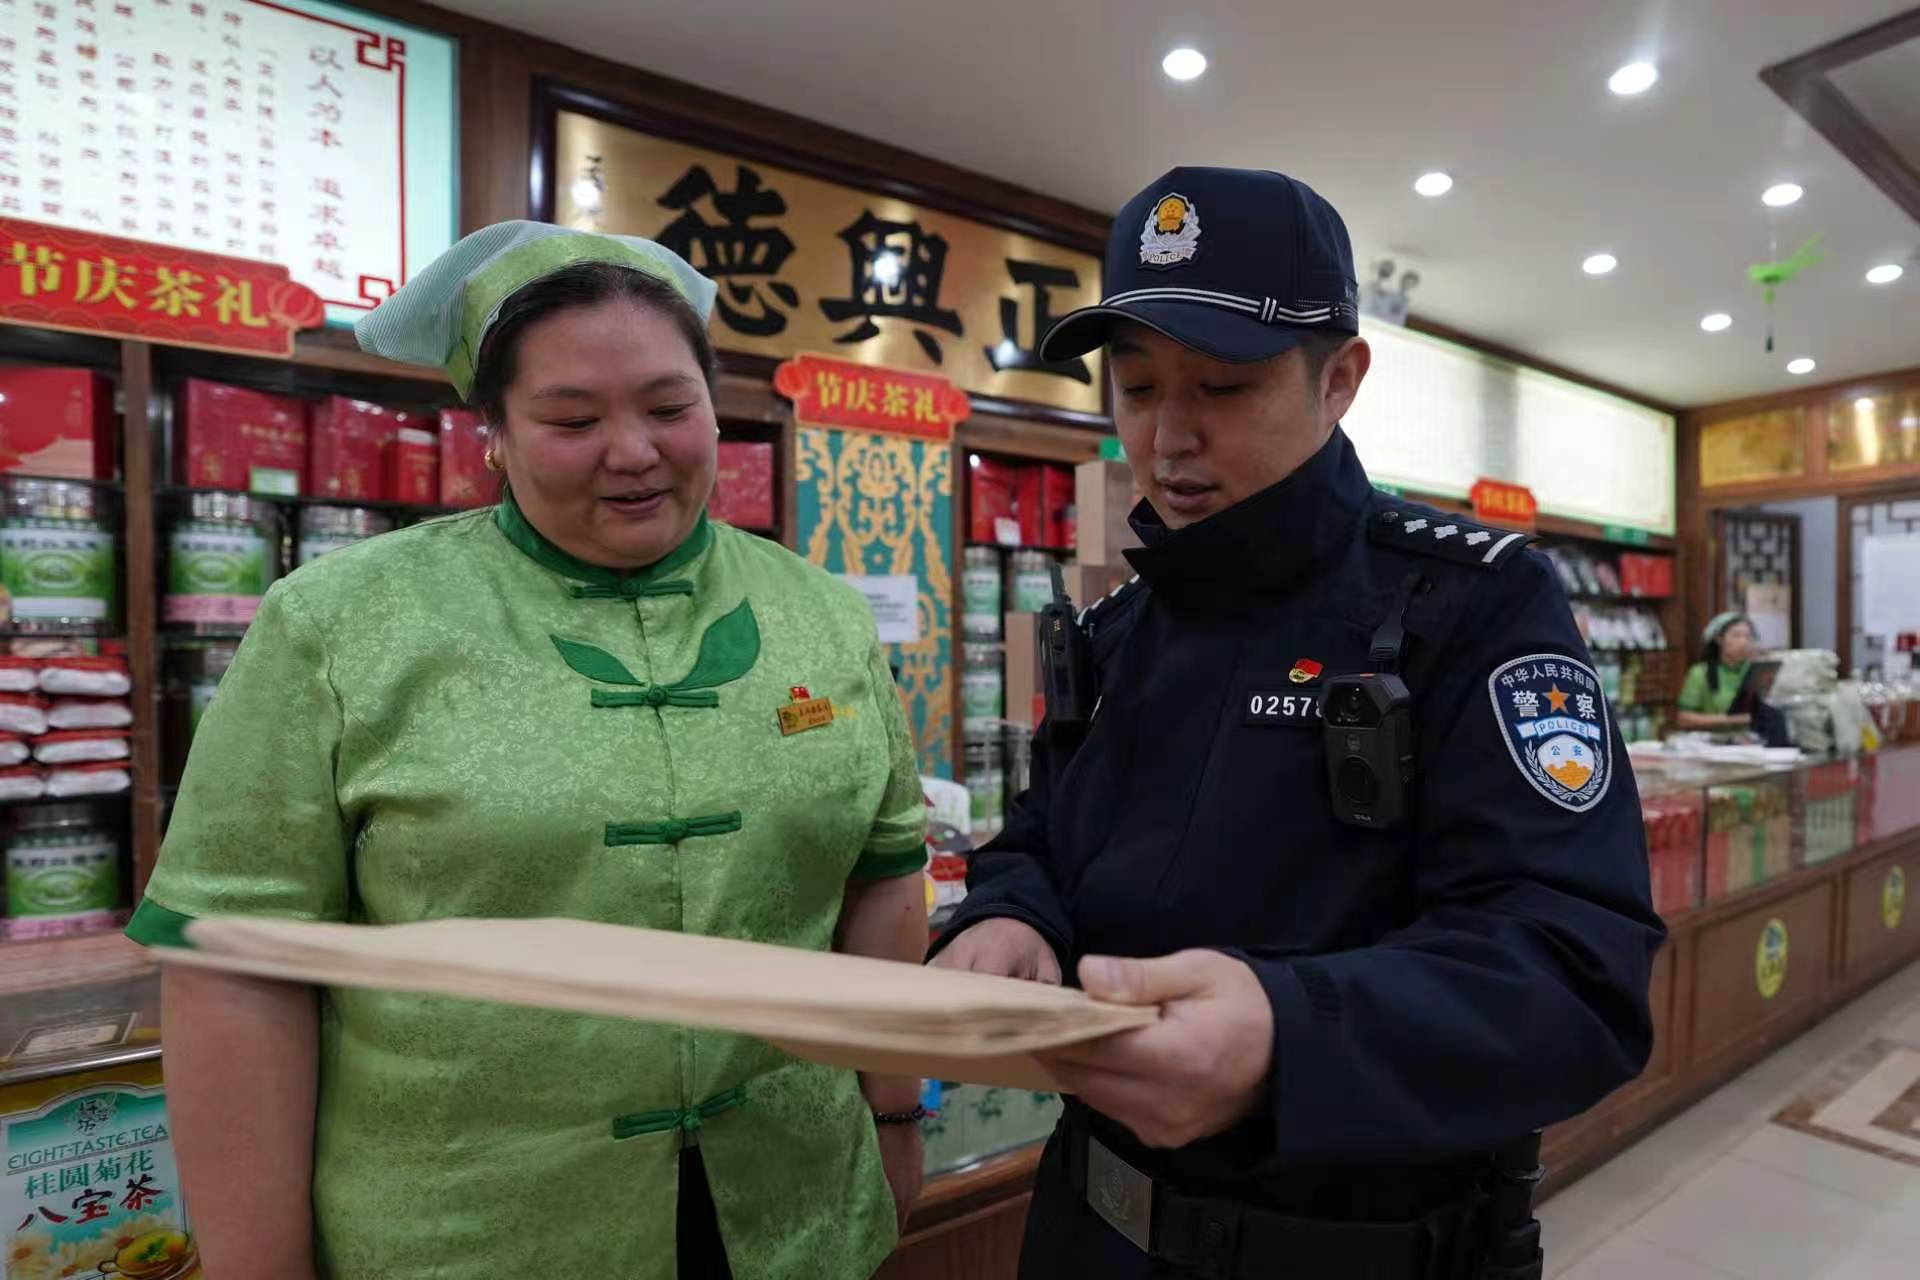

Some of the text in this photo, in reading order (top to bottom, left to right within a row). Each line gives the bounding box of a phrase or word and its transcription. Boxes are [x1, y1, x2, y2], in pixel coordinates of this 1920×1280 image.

[10, 242, 269, 328] 节庆茶礼
[816, 371, 941, 424] 节庆茶礼
[1501, 663, 1596, 693] 中华人民共和国
[1539, 722, 1586, 733] POLICE
[1551, 745, 1584, 757] 公安
[24, 1149, 155, 1199] 桂圆菊花
[16, 1173, 163, 1232] 八宝茶
